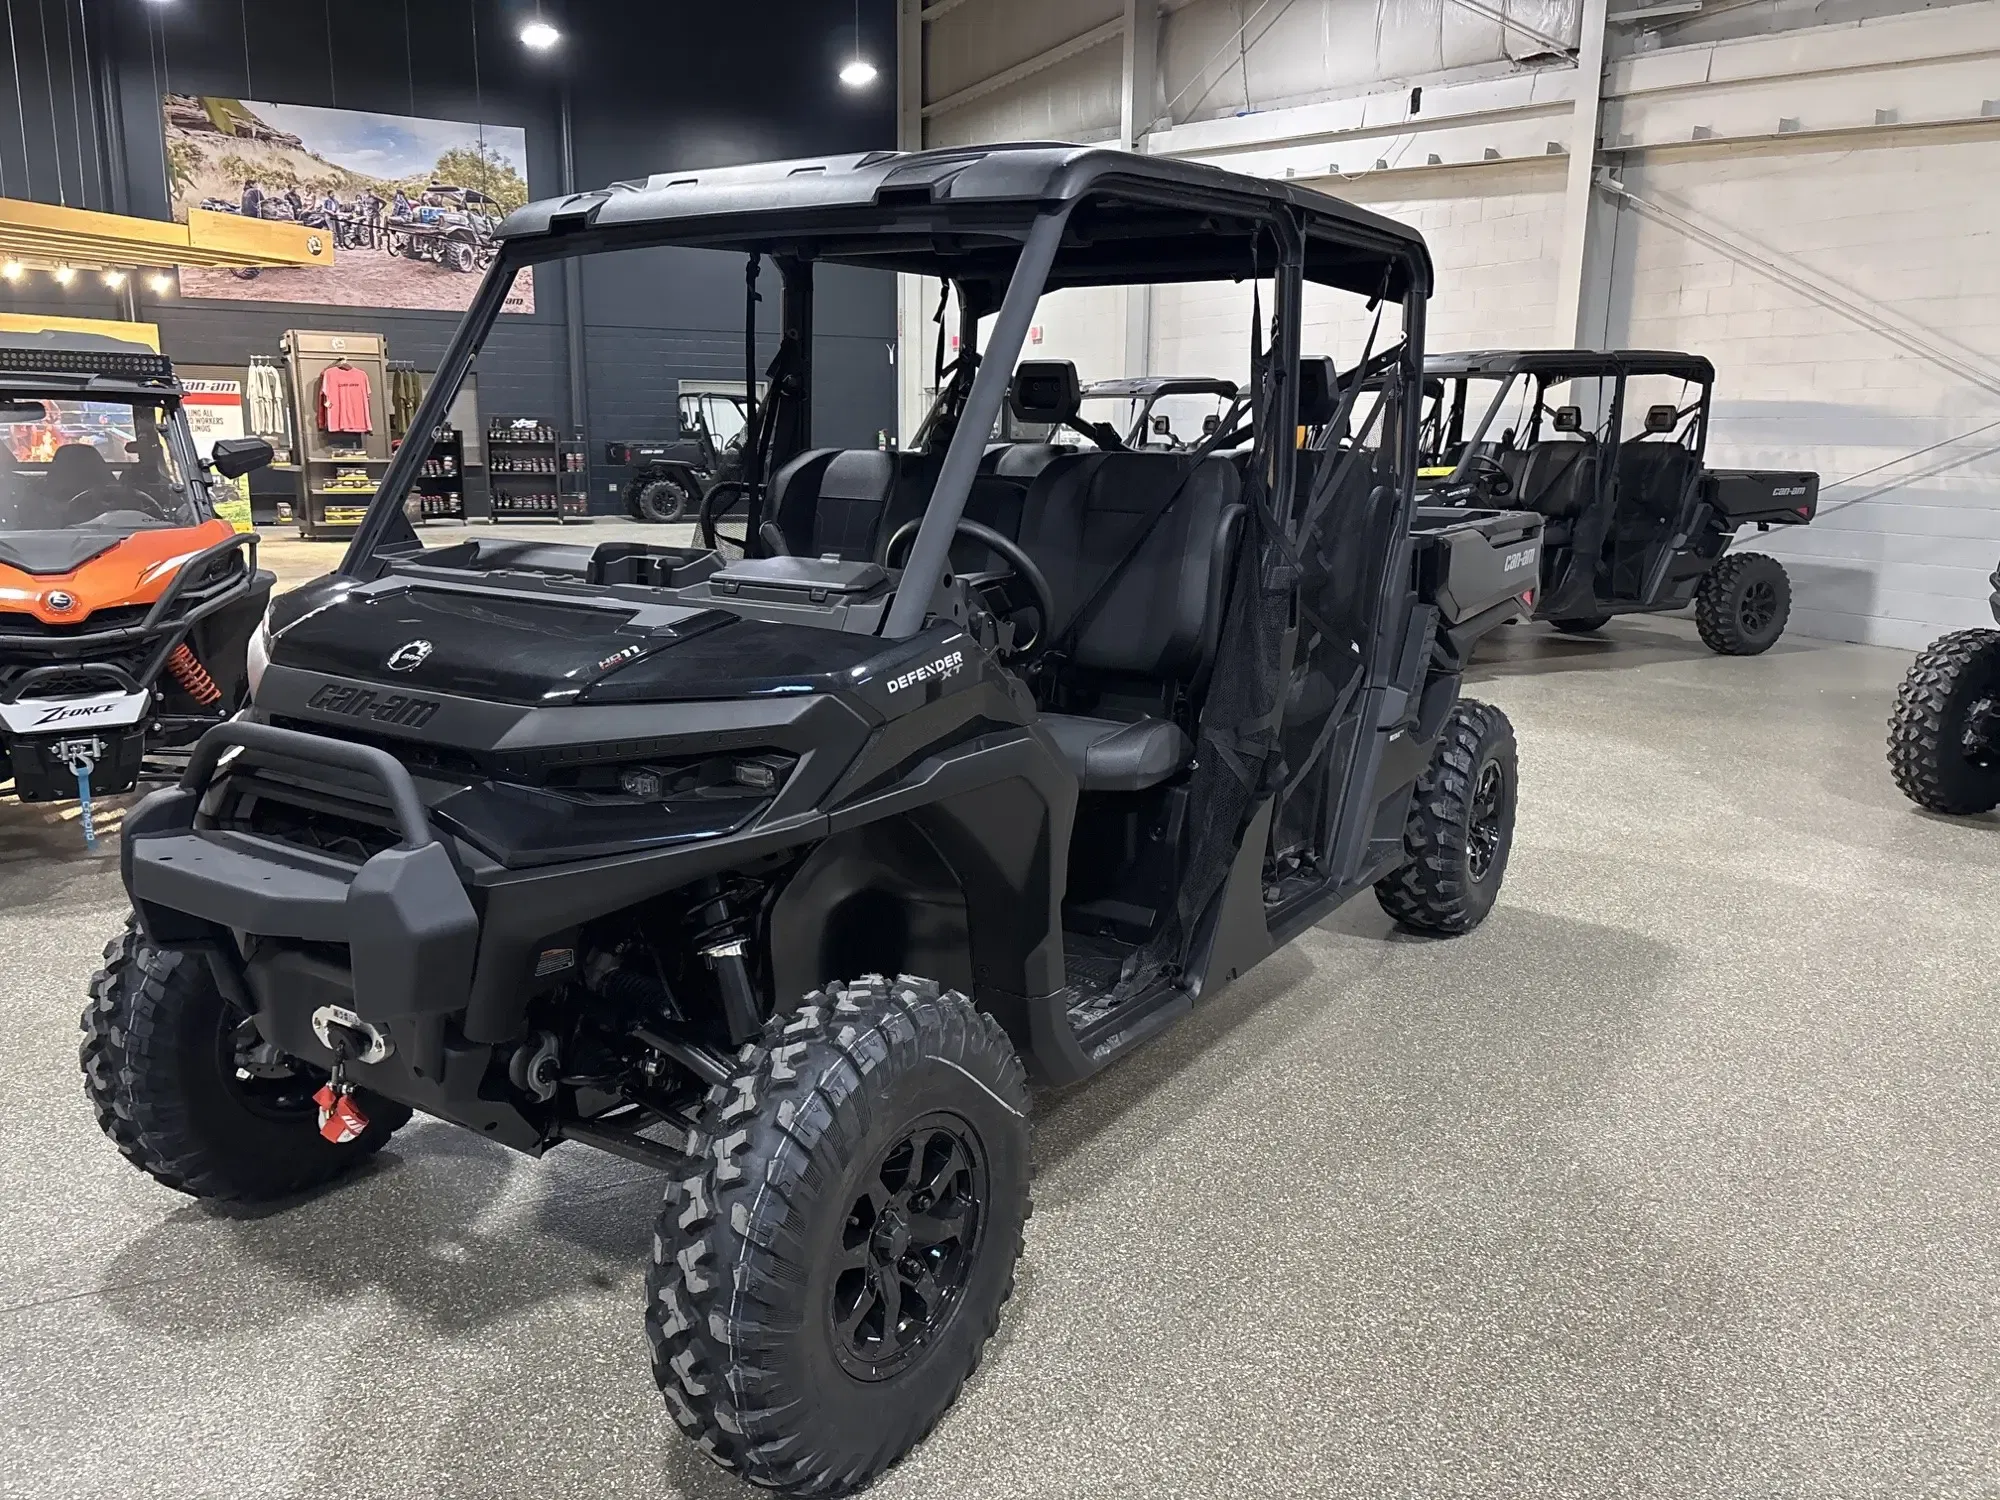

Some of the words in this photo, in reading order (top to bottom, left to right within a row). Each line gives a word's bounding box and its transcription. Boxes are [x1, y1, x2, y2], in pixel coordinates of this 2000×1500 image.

[183, 381, 236, 391] an-am
[1772, 486, 1805, 495] can-am
[1504, 547, 1535, 572] can-am
[886, 651, 963, 693] DEFENDER
[941, 663, 963, 680] XT
[32, 703, 117, 726] ZFORCE
[306, 684, 440, 729] can-am
